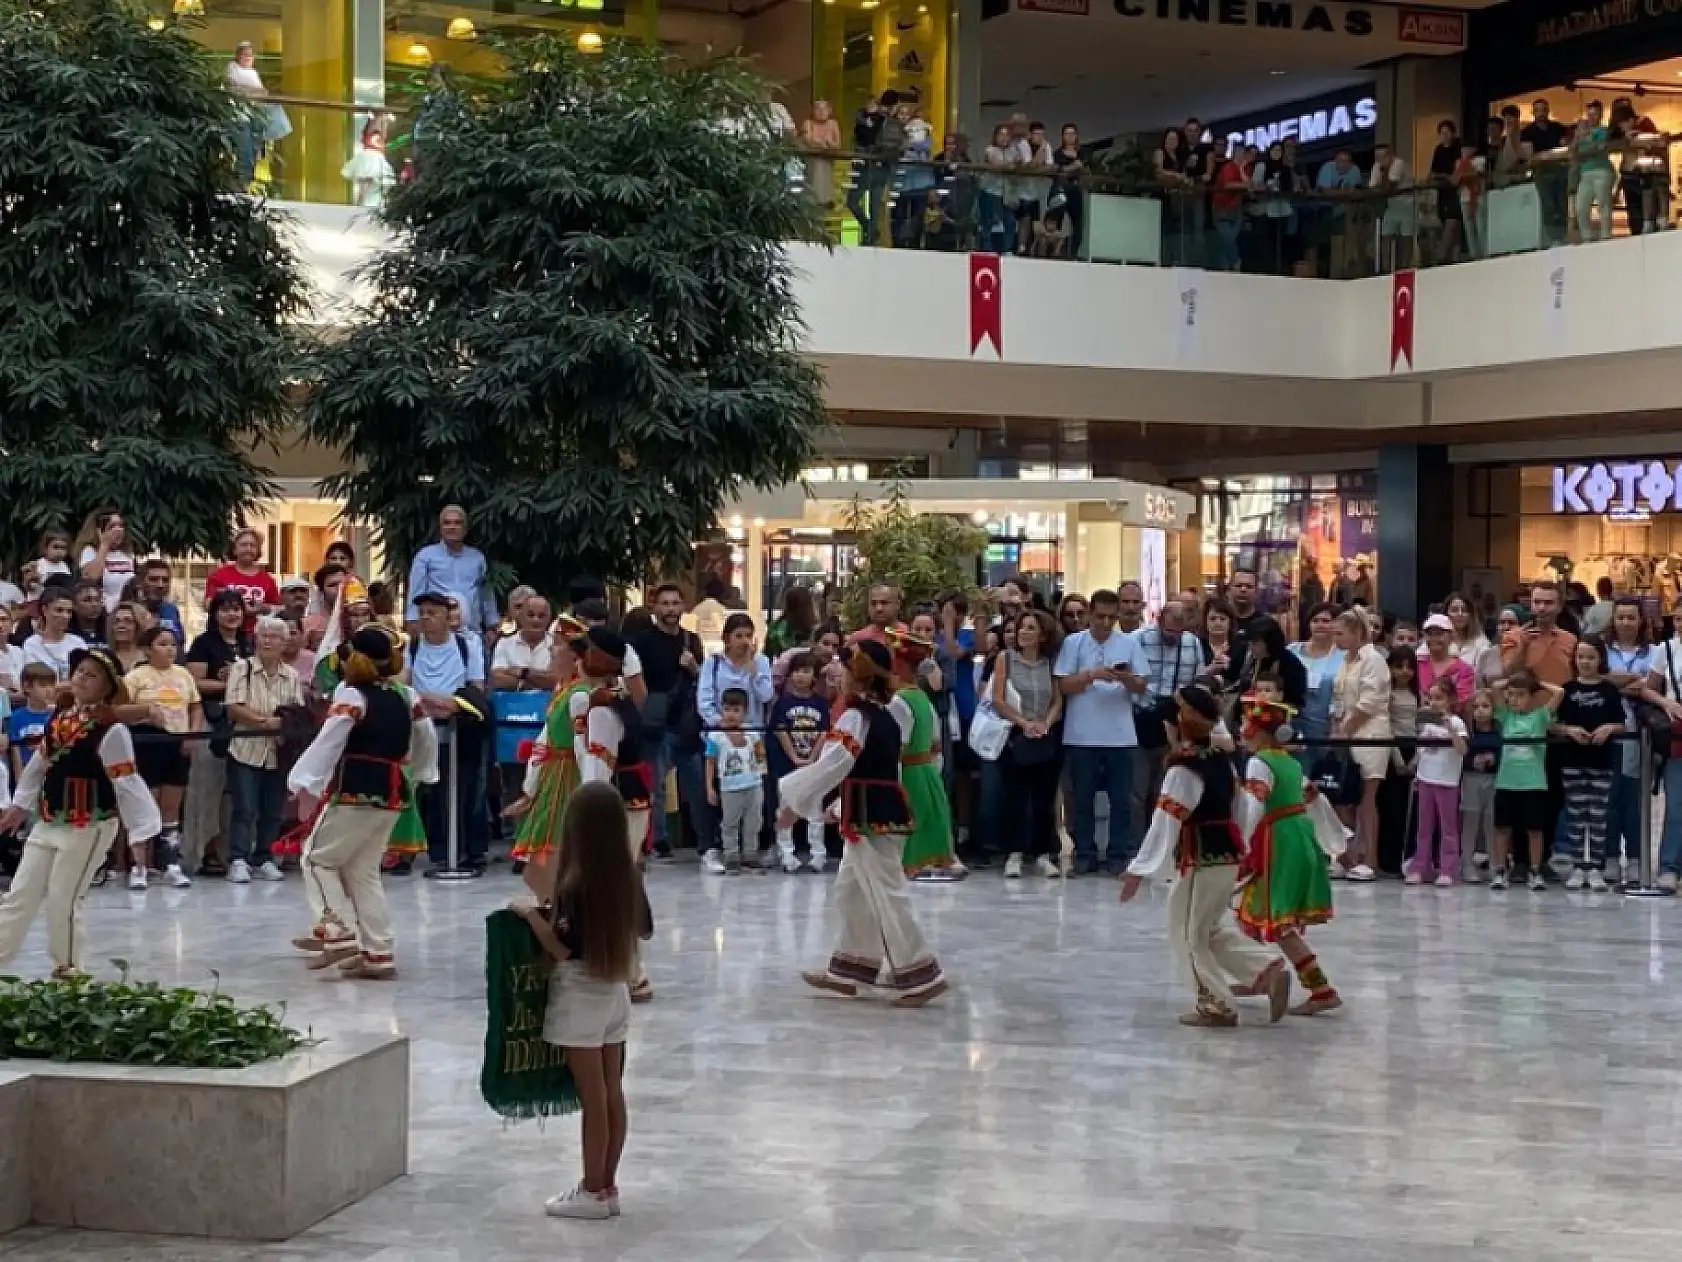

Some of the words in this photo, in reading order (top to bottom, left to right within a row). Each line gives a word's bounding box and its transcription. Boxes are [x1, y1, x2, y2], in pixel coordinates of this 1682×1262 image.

[1113, 0, 1374, 36] CINEMAS
[1225, 97, 1377, 159] CINEMAS
[1553, 462, 1682, 513] KOTO
